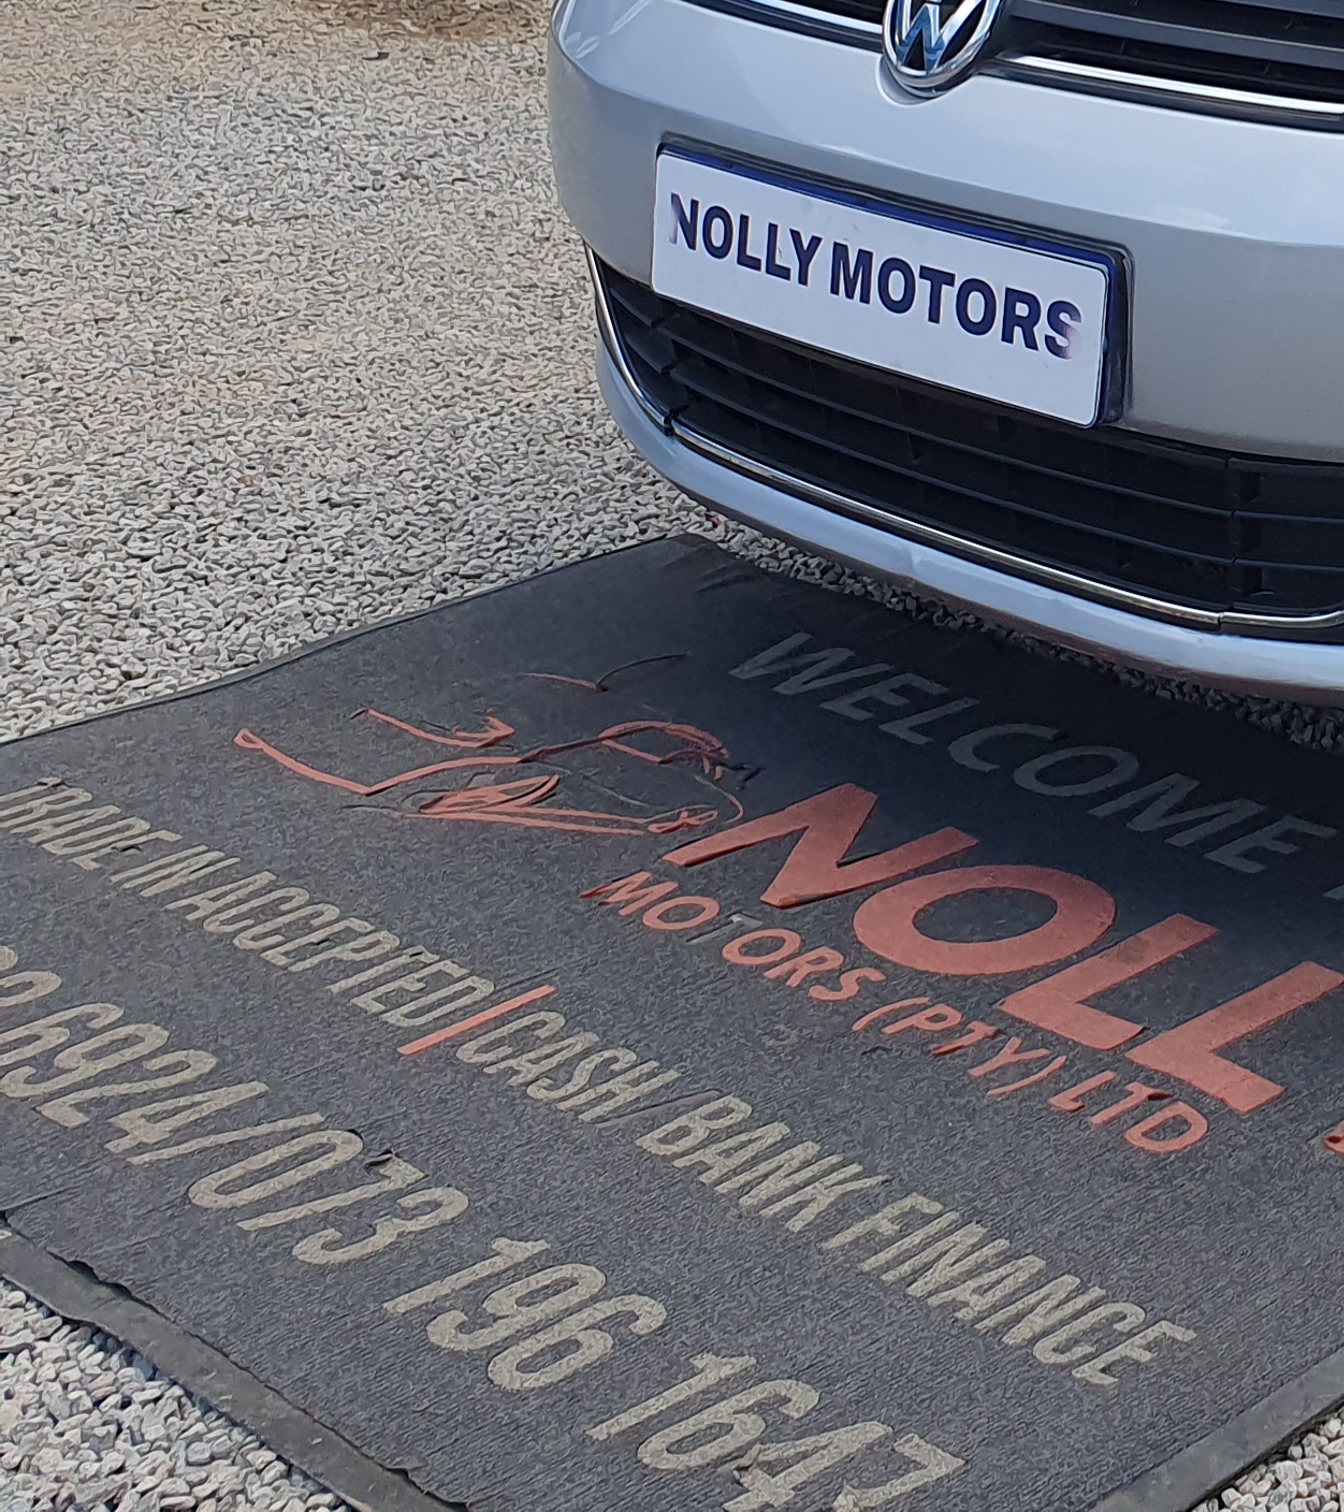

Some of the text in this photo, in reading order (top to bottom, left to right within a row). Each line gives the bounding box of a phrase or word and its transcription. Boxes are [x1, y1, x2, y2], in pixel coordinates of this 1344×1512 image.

[669, 192, 1083, 361] NOLLY MOTORS
[729, 632, 1336, 875] WELCOME
[109, 844, 241, 898] IN
[820, 1192, 1197, 1385] FINANCE
[579, 869, 1209, 1153] MOTORS (PTY) LTD
[383, 1237, 668, 1392] 196
[586, 1353, 966, 1511] 1647
